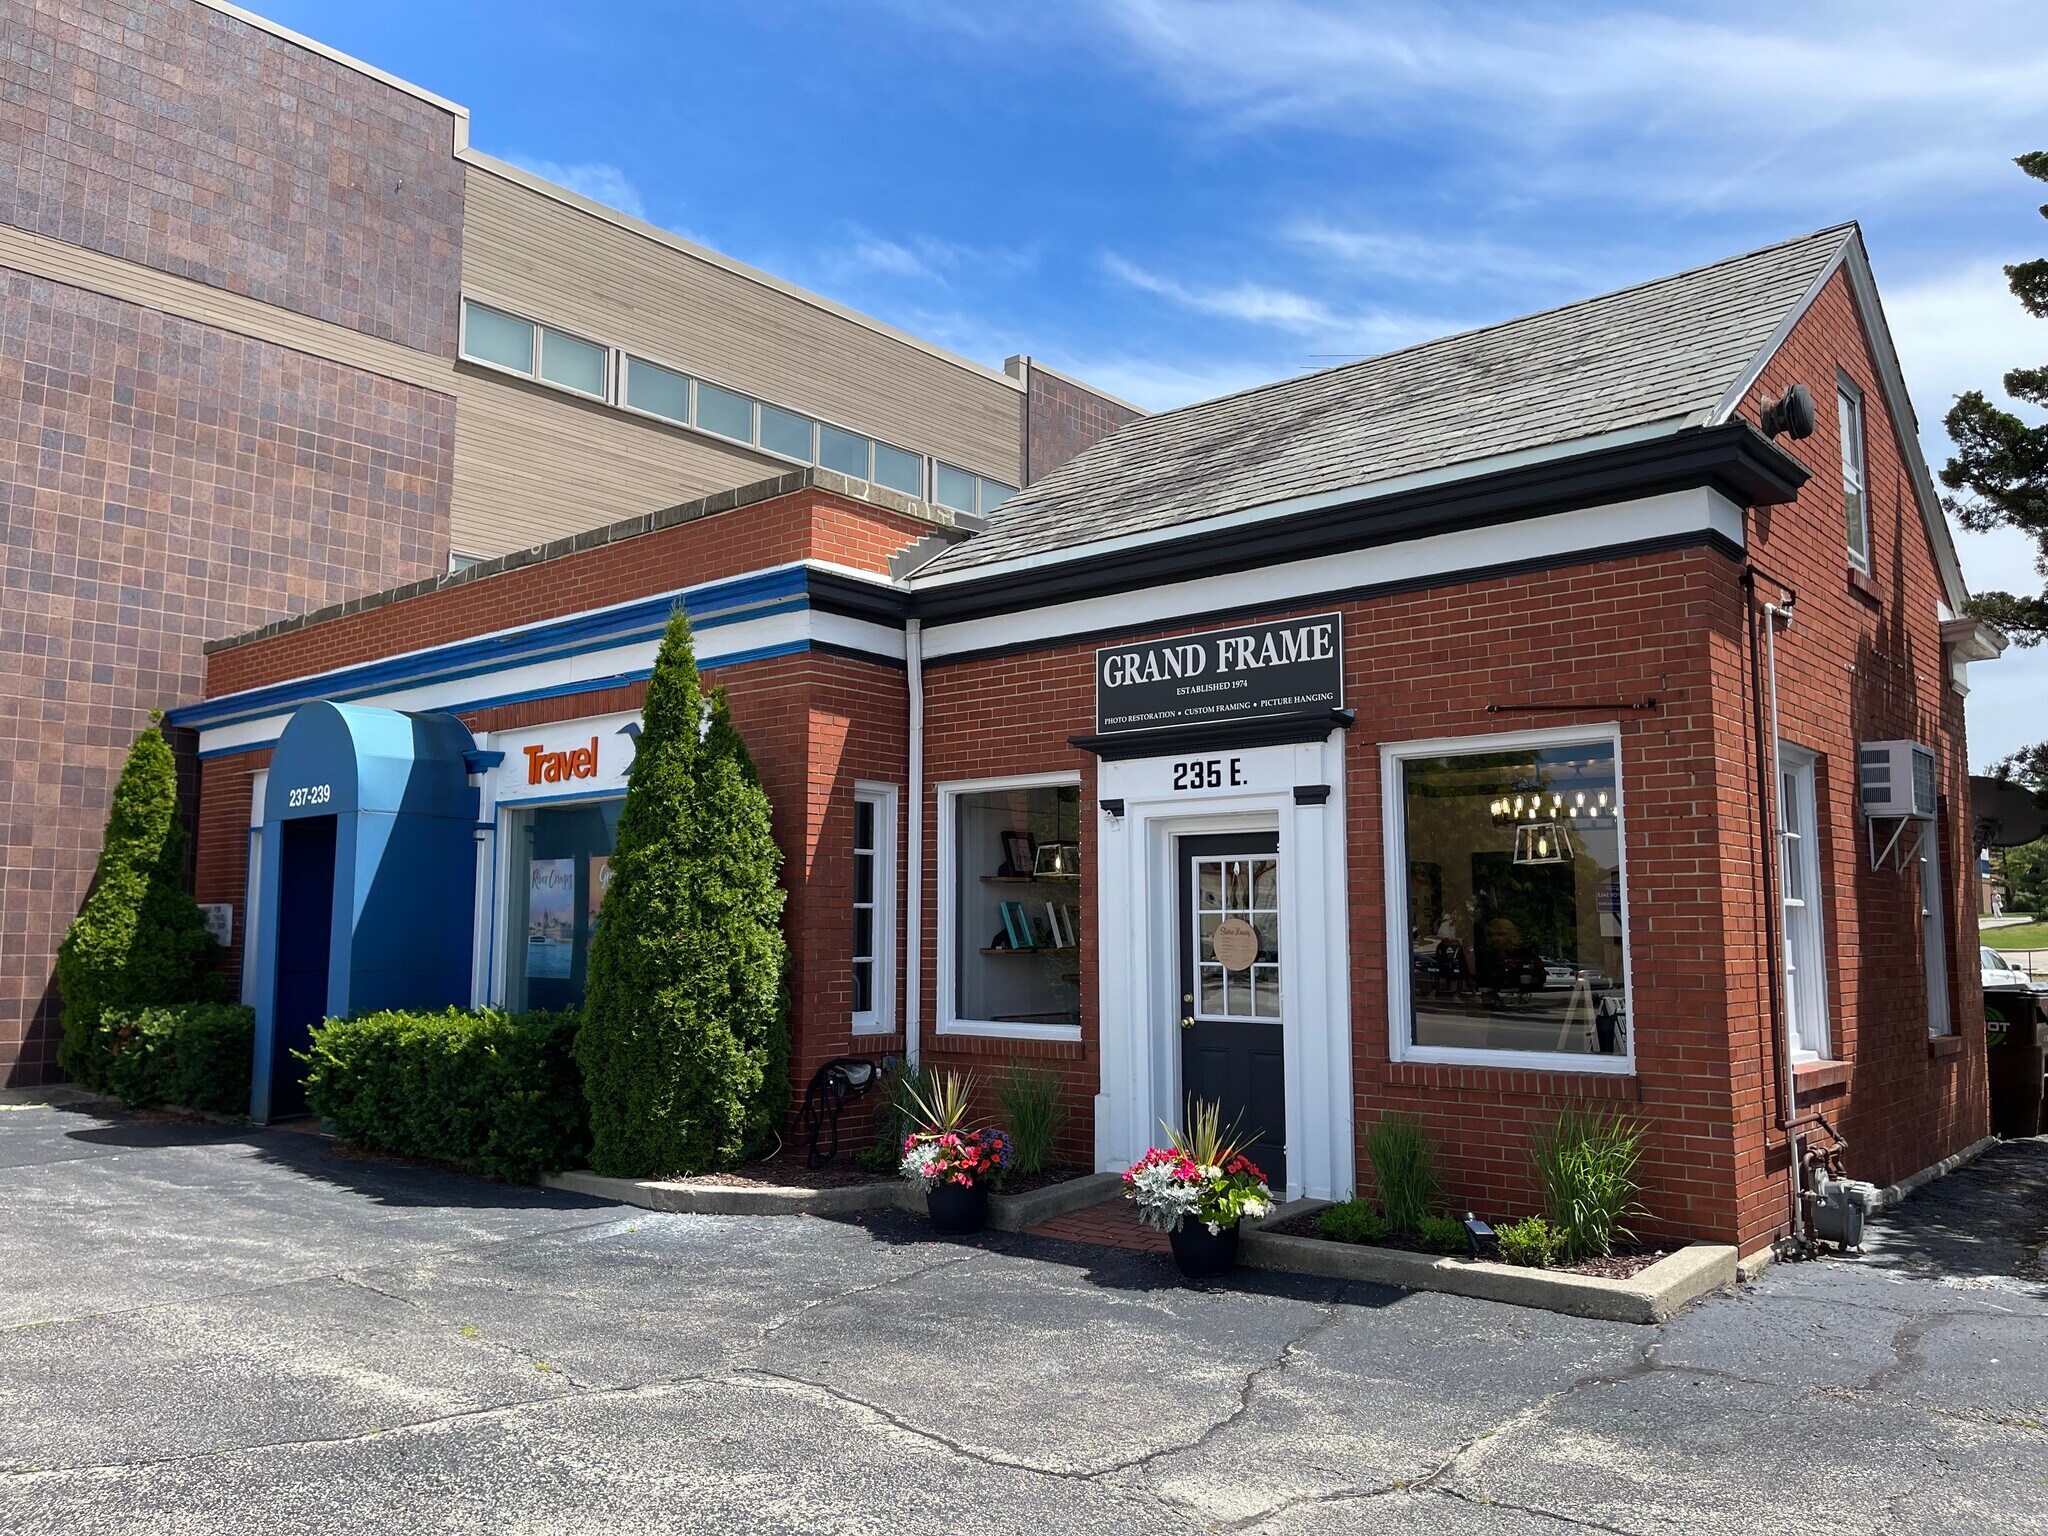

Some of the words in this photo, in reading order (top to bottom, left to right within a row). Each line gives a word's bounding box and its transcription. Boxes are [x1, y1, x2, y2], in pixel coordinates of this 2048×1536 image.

[1103, 644, 1206, 687] GRAND
[1216, 624, 1333, 673] FRAME
[1176, 682, 1231, 696] ESTABLISHED
[1231, 679, 1248, 689] 1974
[1104, 716, 1128, 725] PHOTO
[1128, 710, 1176, 723] RESTORATION
[1184, 705, 1215, 716] CUSTOM
[1216, 702, 1251, 712] FRAMING
[1260, 697, 1293, 707] PICTURE
[1294, 692, 1334, 704] HANGING
[523, 736, 599, 785] Travel
[1173, 760, 1222, 791] 235
[1230, 757, 1248, 787] E.
[289, 784, 331, 807] 237-239
[532, 868, 549, 890] River
[549, 869, 574, 890] Cruises
